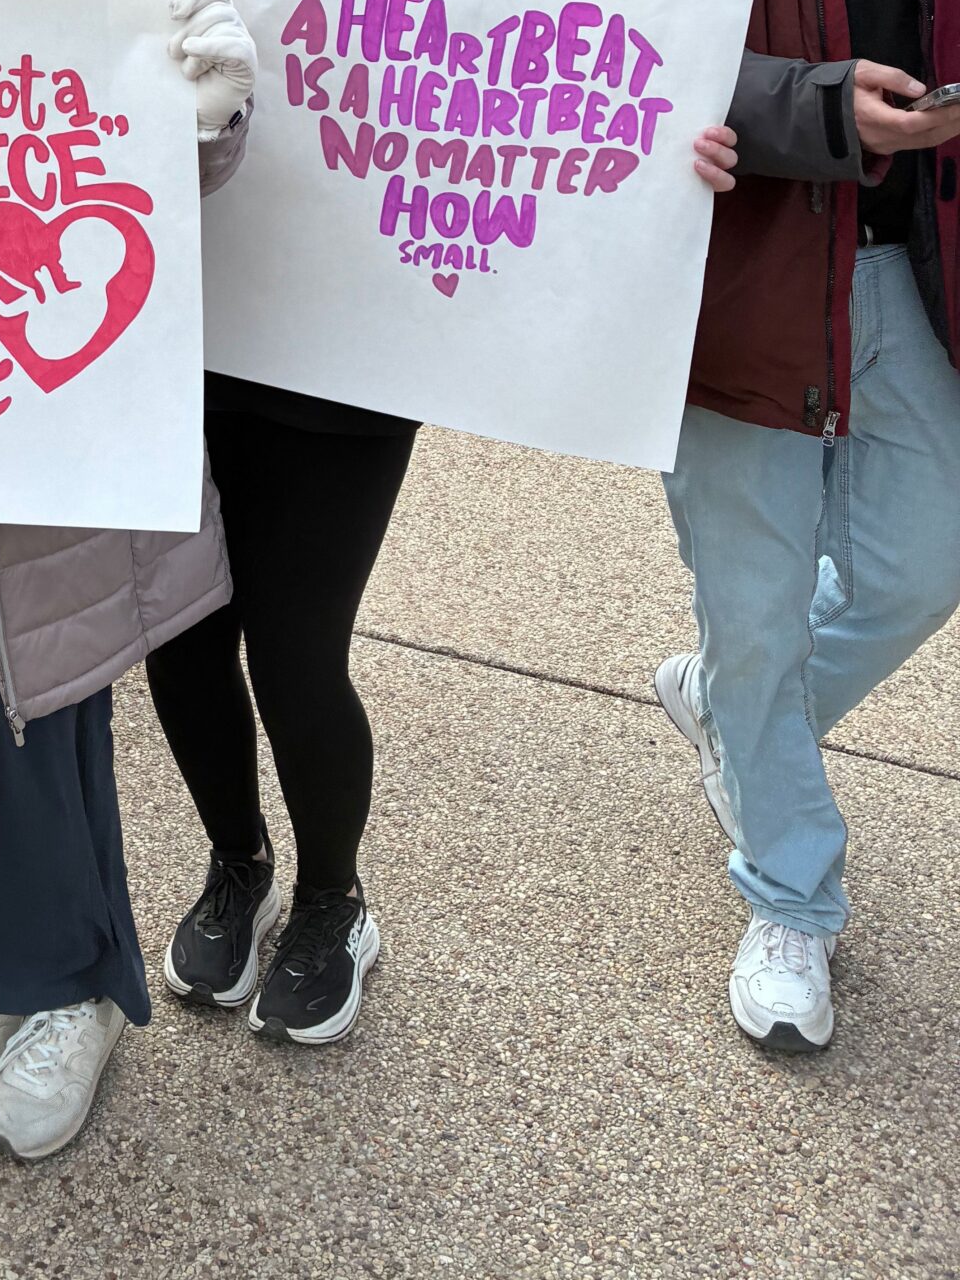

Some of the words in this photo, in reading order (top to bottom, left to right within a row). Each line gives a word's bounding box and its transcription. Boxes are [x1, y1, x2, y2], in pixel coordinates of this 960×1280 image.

[52, 68, 98, 128] a
[285, 53, 335, 112] IS
[340, 63, 370, 119] A
[379, 64, 674, 156] HEARTBEAT
[320, 114, 409, 179] NO
[415, 137, 640, 196] MATTER
[379, 174, 537, 248] HOW
[398, 240, 499, 275] SMALL.
